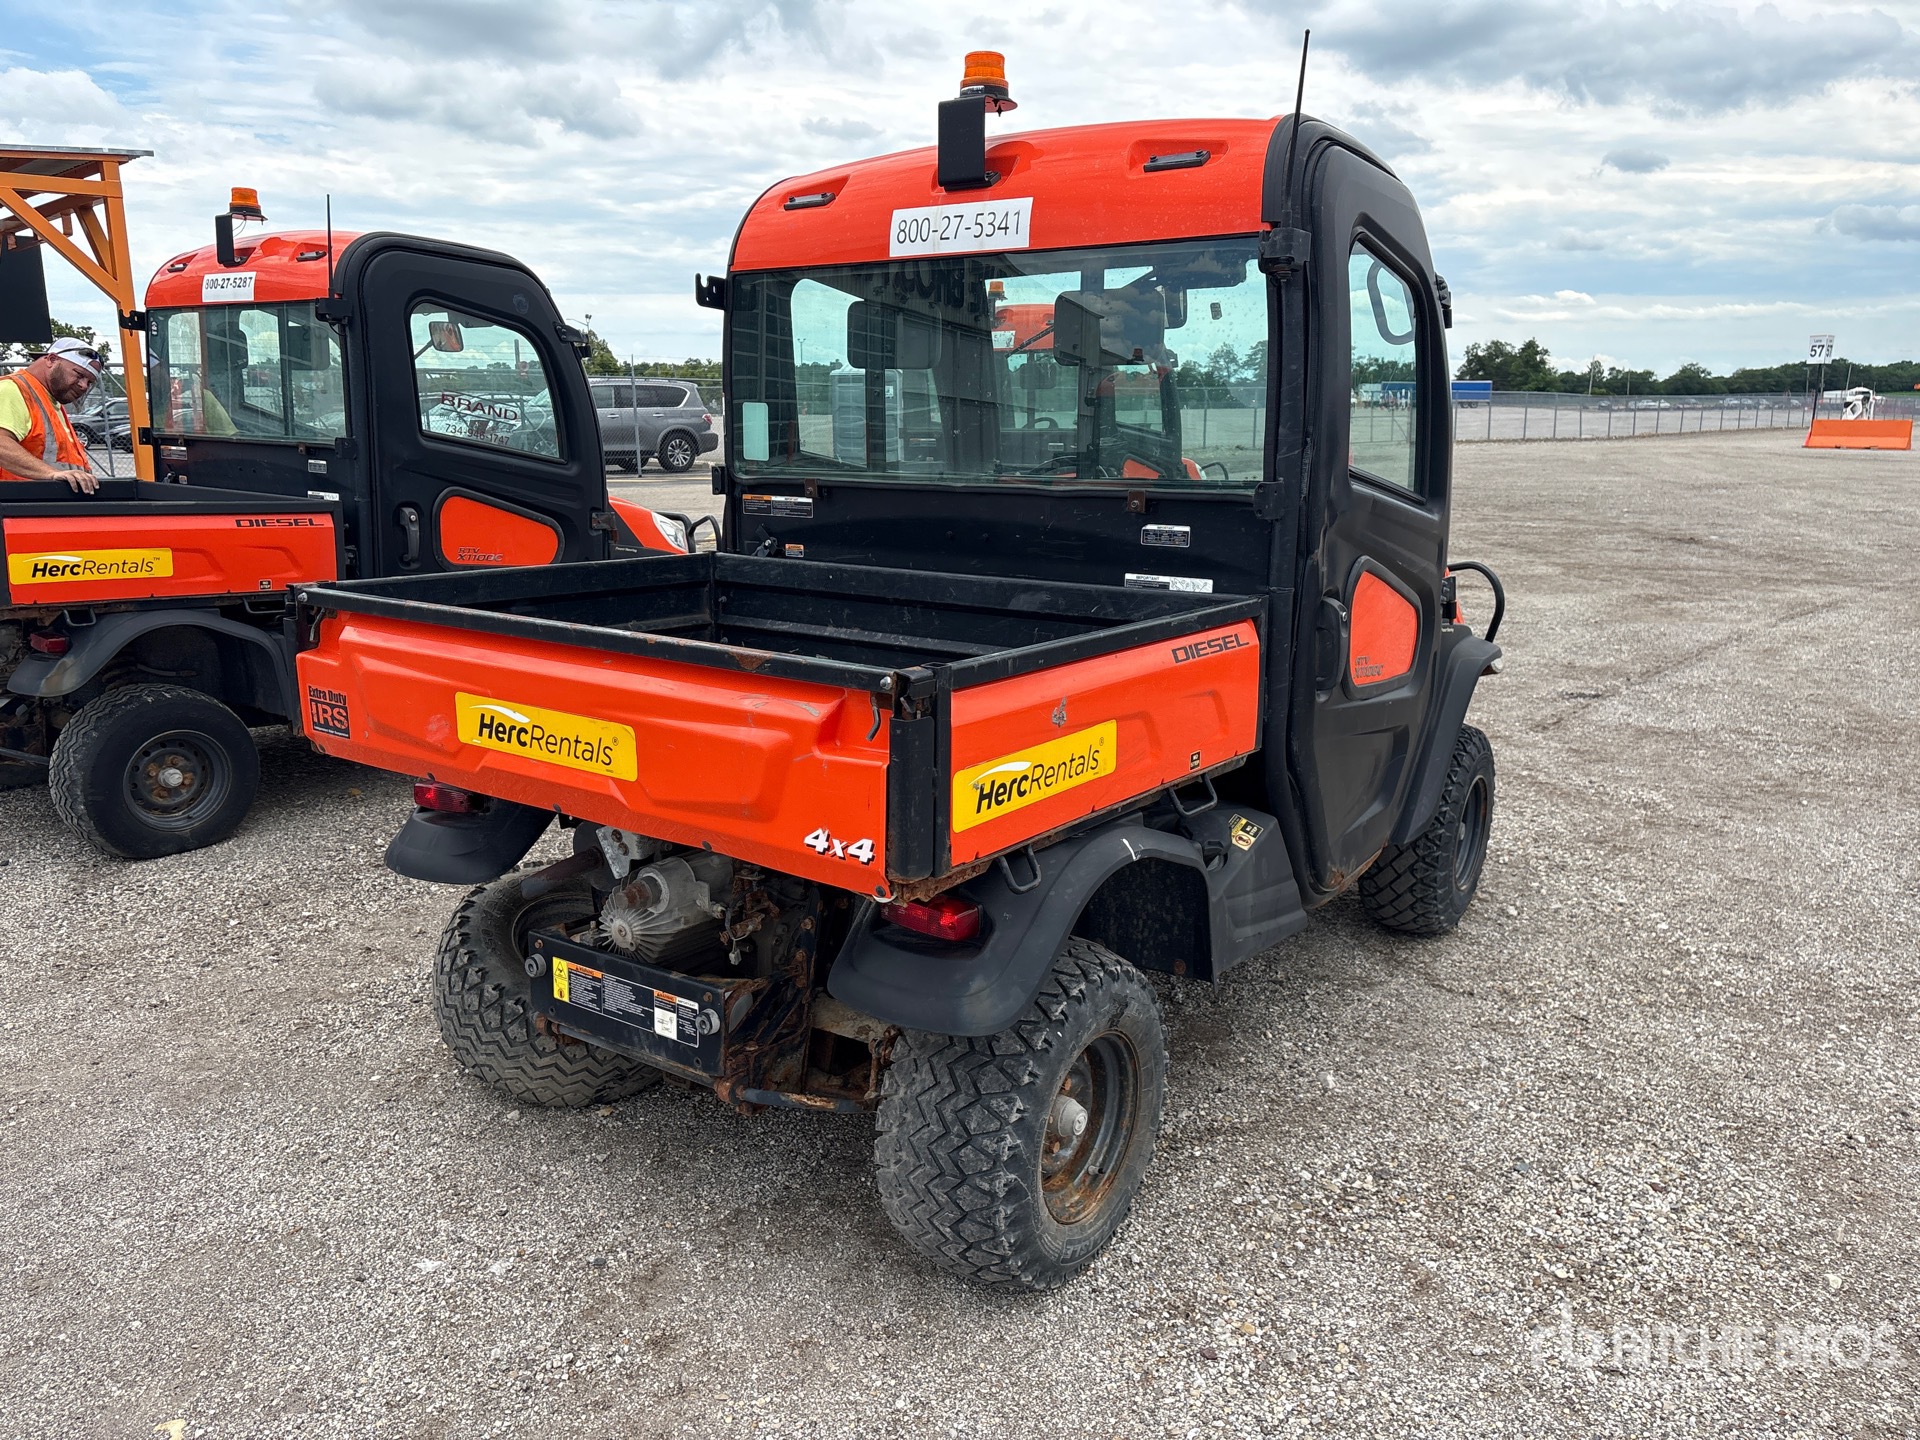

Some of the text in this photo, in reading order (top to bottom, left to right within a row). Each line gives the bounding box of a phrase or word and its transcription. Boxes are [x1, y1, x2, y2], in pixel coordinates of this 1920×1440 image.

[896, 209, 1021, 244] 800-27-5341
[205, 276, 253, 290] 800-27-5287
[1809, 344, 1825, 357] 57
[441, 393, 518, 421] BRAND
[235, 518, 325, 528] DIESEL
[1171, 633, 1250, 663] DIESEL
[308, 685, 347, 706] Extra Duty
[311, 701, 349, 730] IRS
[803, 828, 876, 866] 4x4
